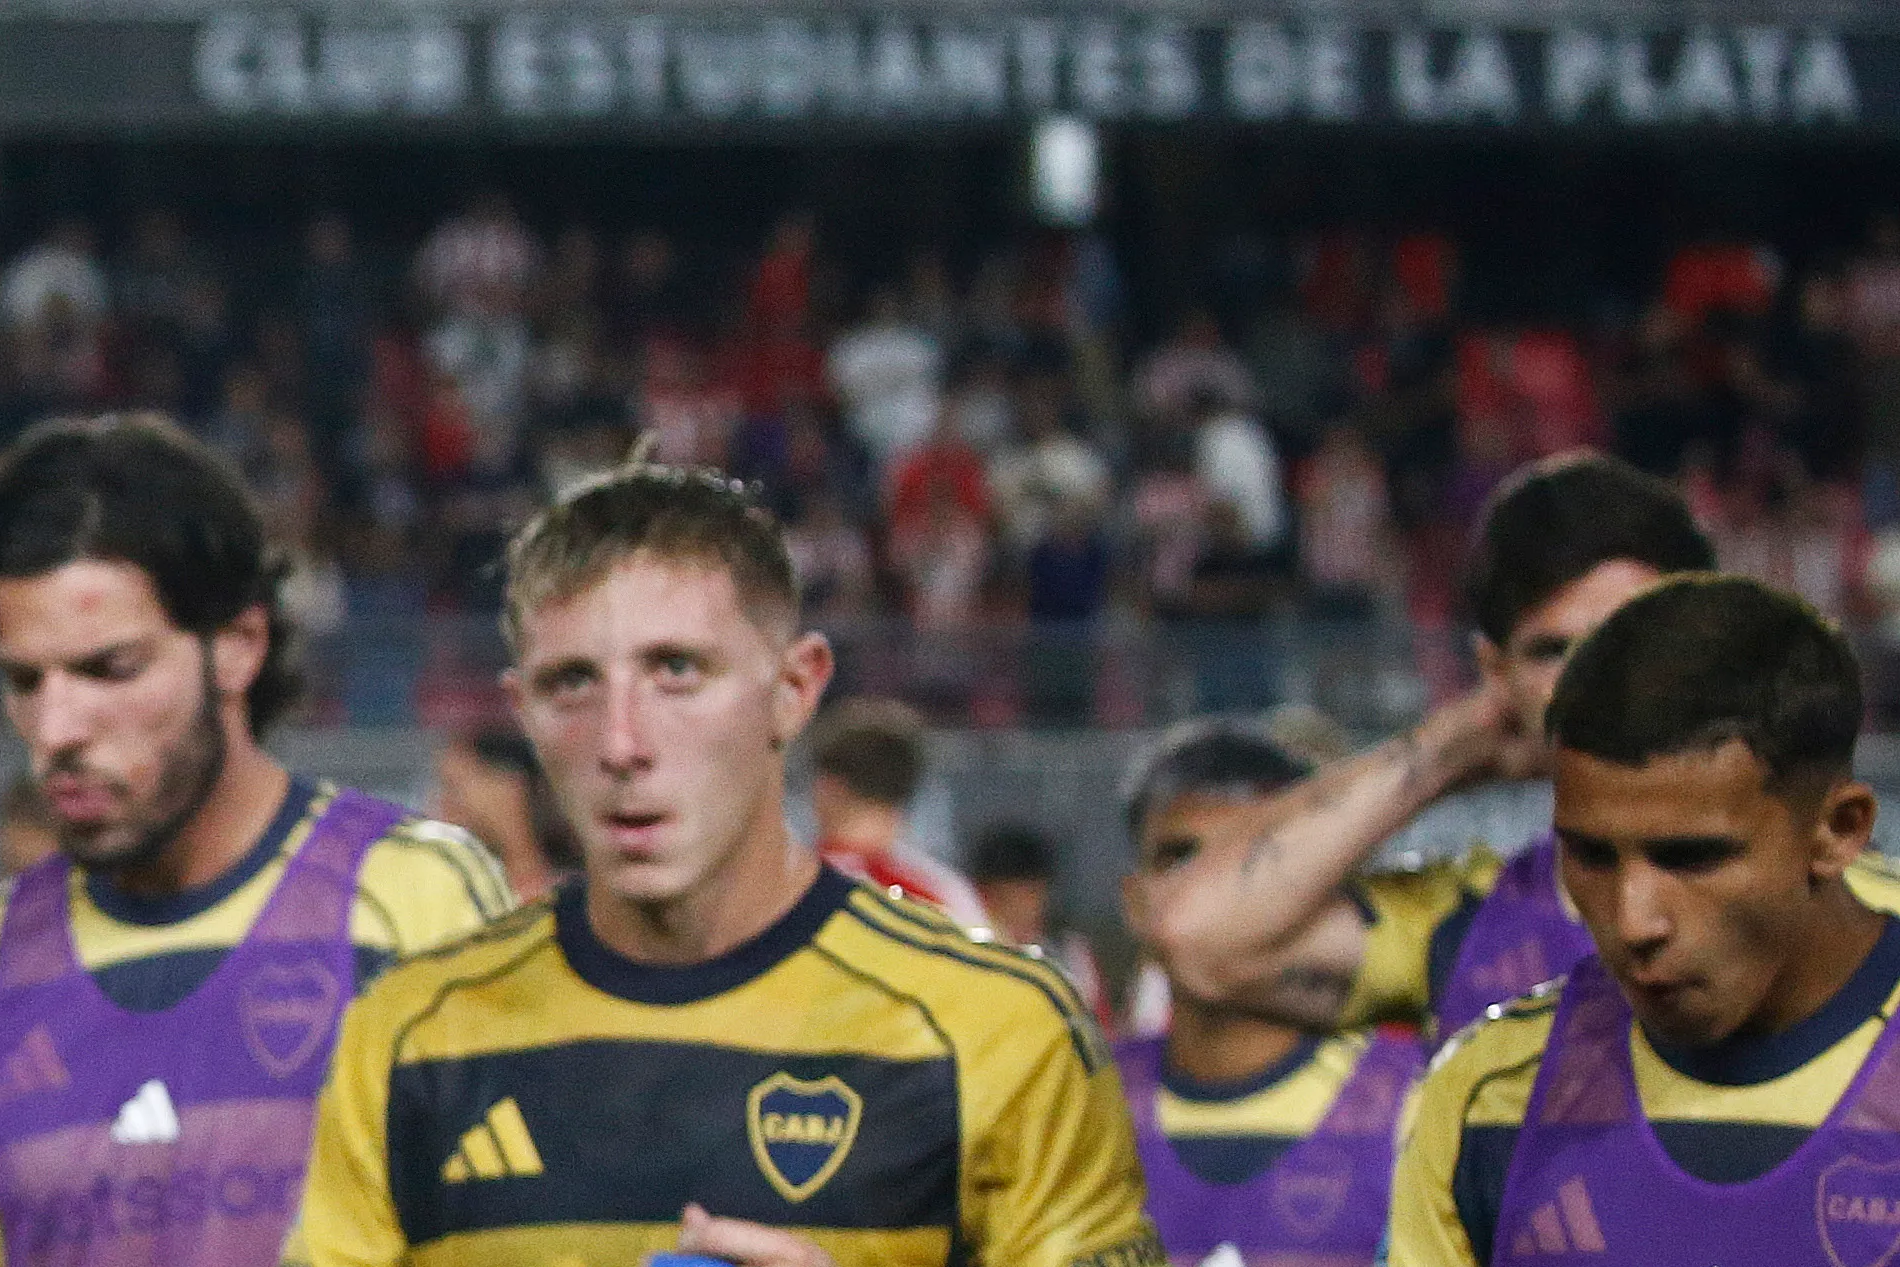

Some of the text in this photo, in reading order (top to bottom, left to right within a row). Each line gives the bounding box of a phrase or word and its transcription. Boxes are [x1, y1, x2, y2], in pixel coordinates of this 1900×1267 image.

[195, 15, 1858, 126] CLUB ESTUDIANTES DE LA PLATA
